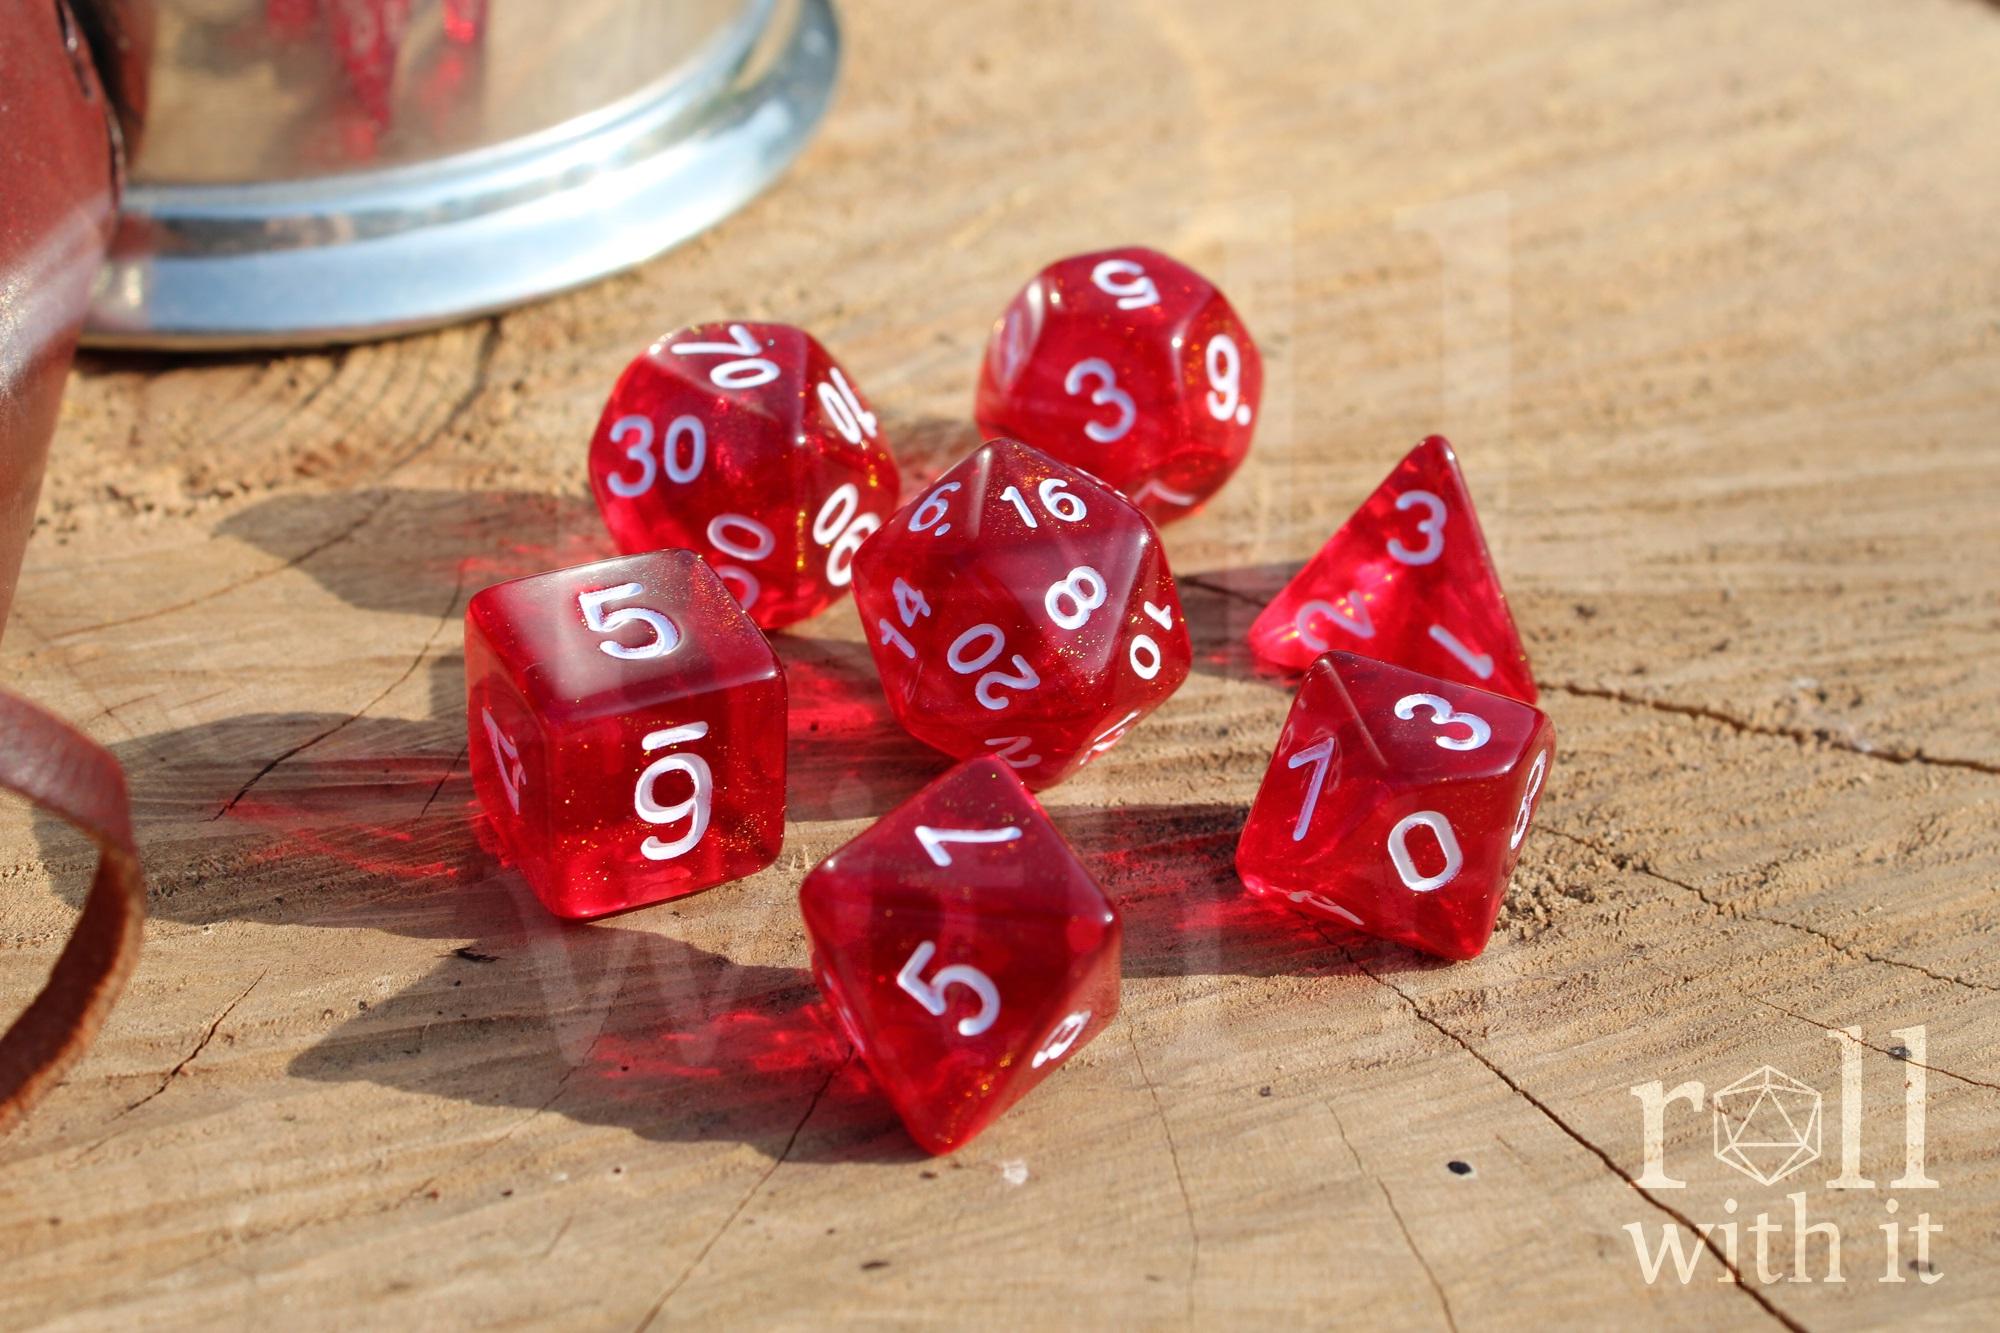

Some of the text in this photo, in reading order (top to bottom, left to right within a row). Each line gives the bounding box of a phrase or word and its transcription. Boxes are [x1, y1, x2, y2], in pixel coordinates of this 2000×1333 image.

[1092, 259, 1161, 311] 5
[670, 324, 780, 389] 70
[1065, 357, 1136, 443] 3
[606, 415, 706, 498] 30
[1000, 478, 1087, 529] 16
[1386, 489, 1447, 566] 3
[578, 582, 681, 660] 5
[879, 577, 931, 659] 14
[1045, 565, 1108, 630] 8
[1295, 590, 1376, 652] 2
[947, 623, 1041, 710] 20
[1130, 600, 1173, 680] 10
[1428, 623, 1495, 680] 1
[1394, 693, 1492, 751] 3
[1510, 748, 1547, 850] 8
[1387, 810, 1464, 893] 0
[896, 940, 1001, 1037] 5
